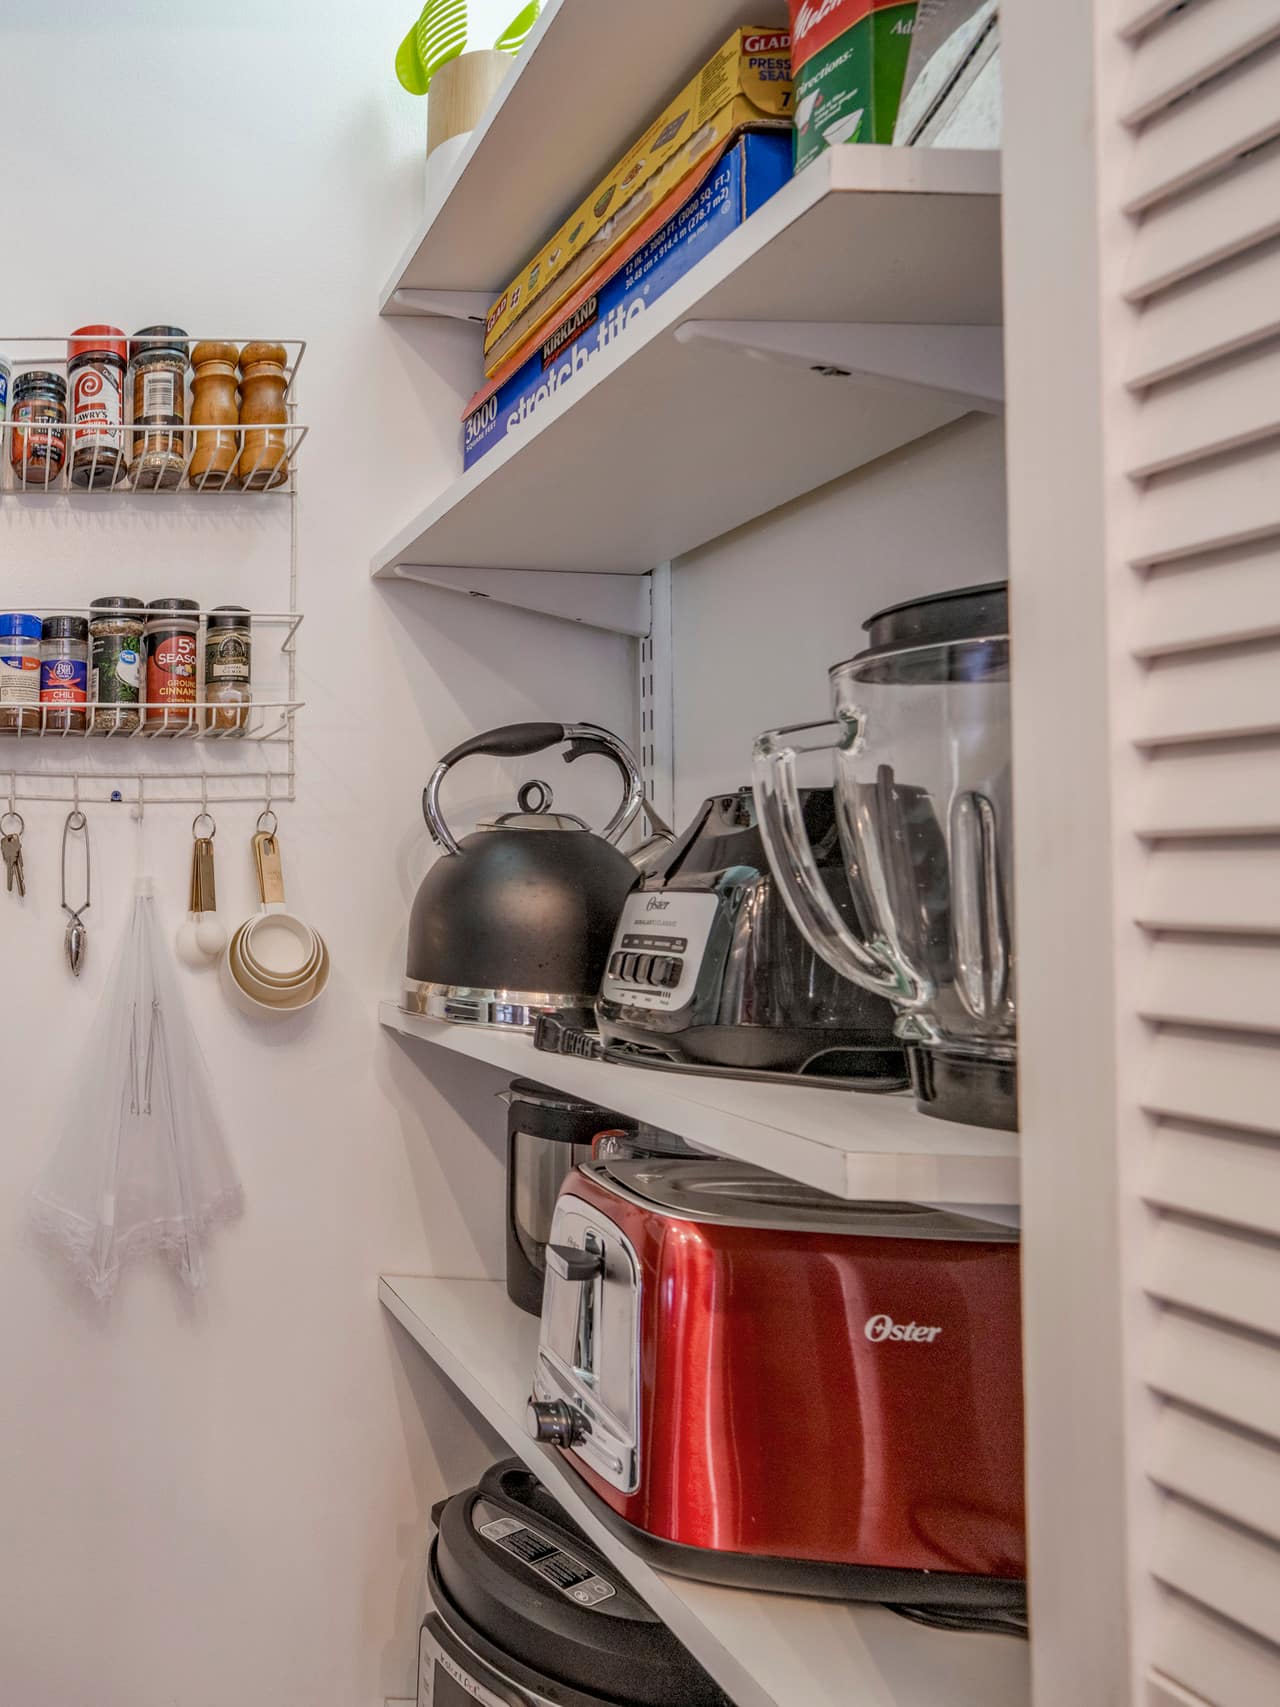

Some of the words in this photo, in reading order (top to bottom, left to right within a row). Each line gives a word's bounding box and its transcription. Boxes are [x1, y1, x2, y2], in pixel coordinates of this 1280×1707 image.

[744, 36, 791, 52] GLAD
[749, 58, 791, 69] PRESS
[543, 296, 597, 359] KIRKLAND
[74, 410, 108, 423] LAWRY'S
[465, 395, 497, 445] 3000
[158, 653, 196, 665] SEASO
[53, 691, 74, 699] CHILI
[159, 688, 196, 697] CINNAM
[864, 1314, 942, 1343] Oster
